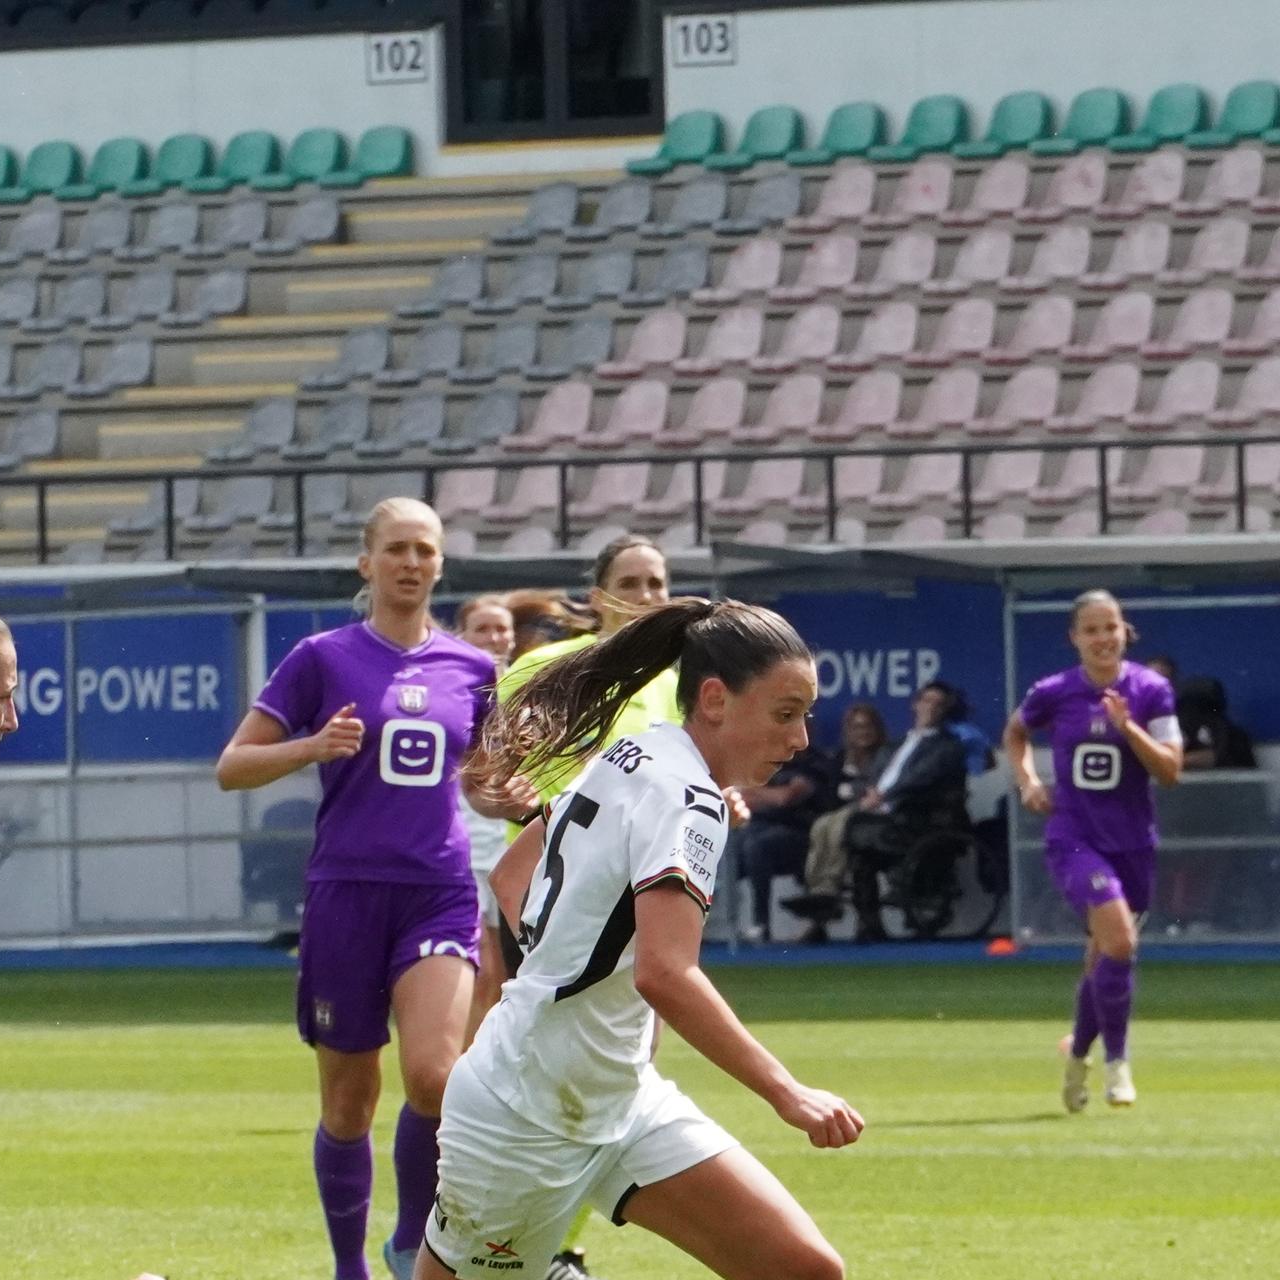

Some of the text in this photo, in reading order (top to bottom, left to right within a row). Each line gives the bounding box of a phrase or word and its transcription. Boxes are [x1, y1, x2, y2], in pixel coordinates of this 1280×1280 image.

[373, 39, 422, 73] 102
[678, 21, 730, 55] 103
[77, 663, 220, 714] POWER
[816, 648, 941, 698] OWER
